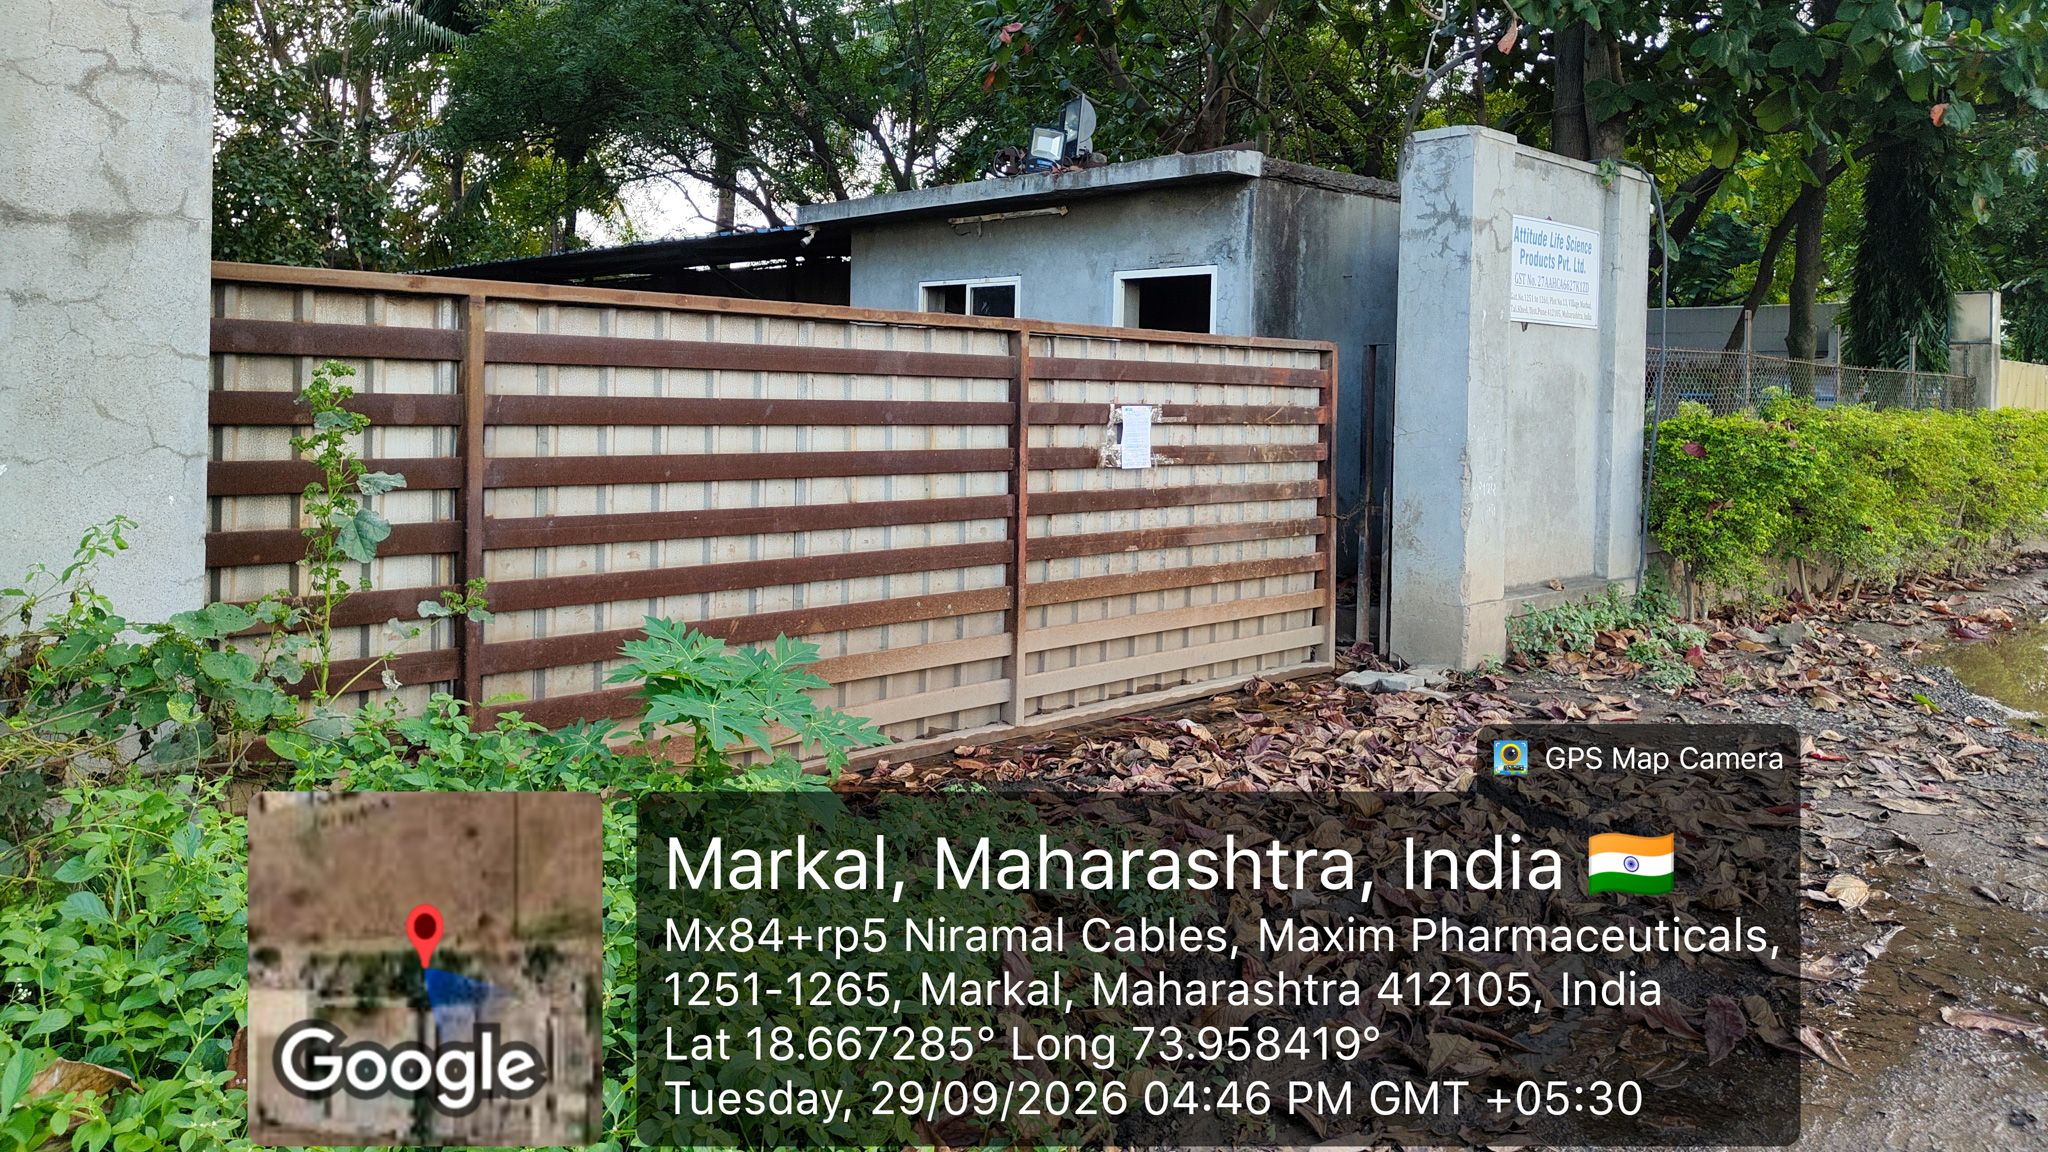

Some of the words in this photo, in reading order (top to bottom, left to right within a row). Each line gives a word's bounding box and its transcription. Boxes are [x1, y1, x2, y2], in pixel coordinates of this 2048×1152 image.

[1514, 225, 1547, 247] Attitude
[1549, 231, 1564, 250] Life
[1566, 235, 1592, 255] Science
[1520, 248, 1556, 270] Products
[1557, 255, 1572, 273] Pvt.
[1574, 257, 1587, 275] Ltd.
[1514, 272, 1527, 285] GST
